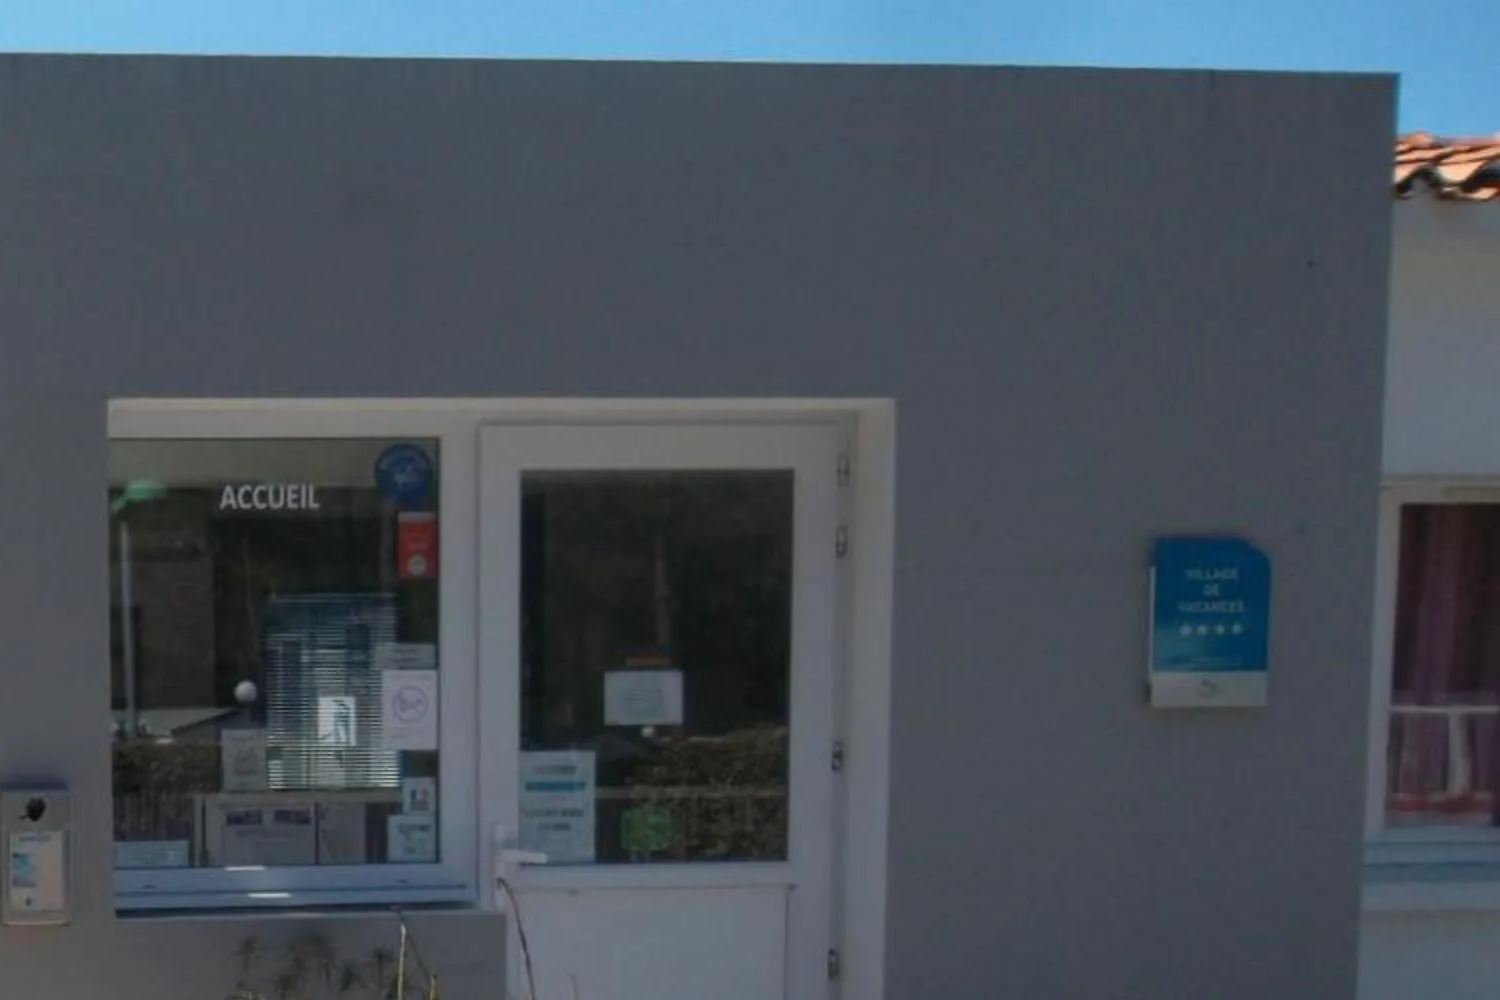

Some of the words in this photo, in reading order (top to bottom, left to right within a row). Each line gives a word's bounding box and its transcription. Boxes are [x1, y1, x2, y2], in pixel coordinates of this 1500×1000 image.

[219, 483, 321, 510] ACCUEIL
[1184, 567, 1240, 581] VILLAGE
[1203, 583, 1220, 596] DE
[1176, 599, 1245, 613] VACANCES
